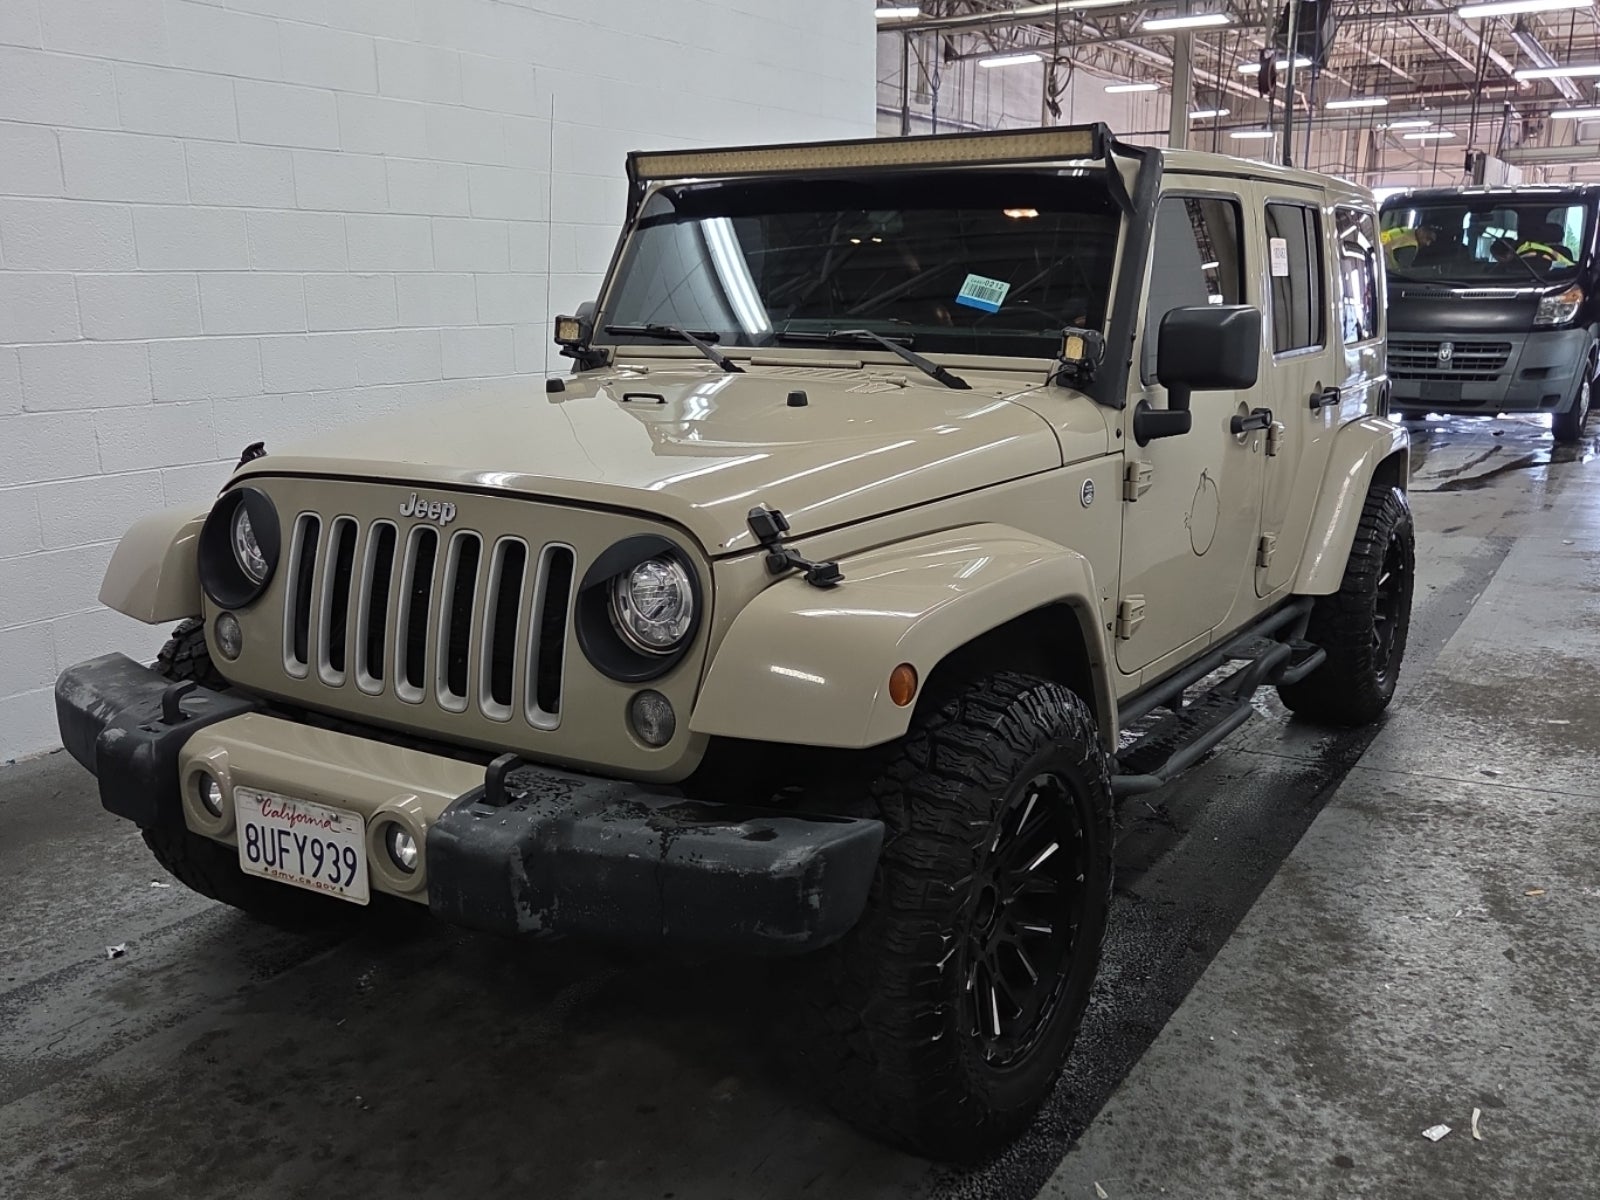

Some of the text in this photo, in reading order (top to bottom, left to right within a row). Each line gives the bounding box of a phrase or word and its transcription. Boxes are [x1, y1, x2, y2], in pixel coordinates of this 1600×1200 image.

[399, 492, 457, 526] Jeep
[261, 798, 340, 834] California
[245, 823, 358, 888] 8UFY939
